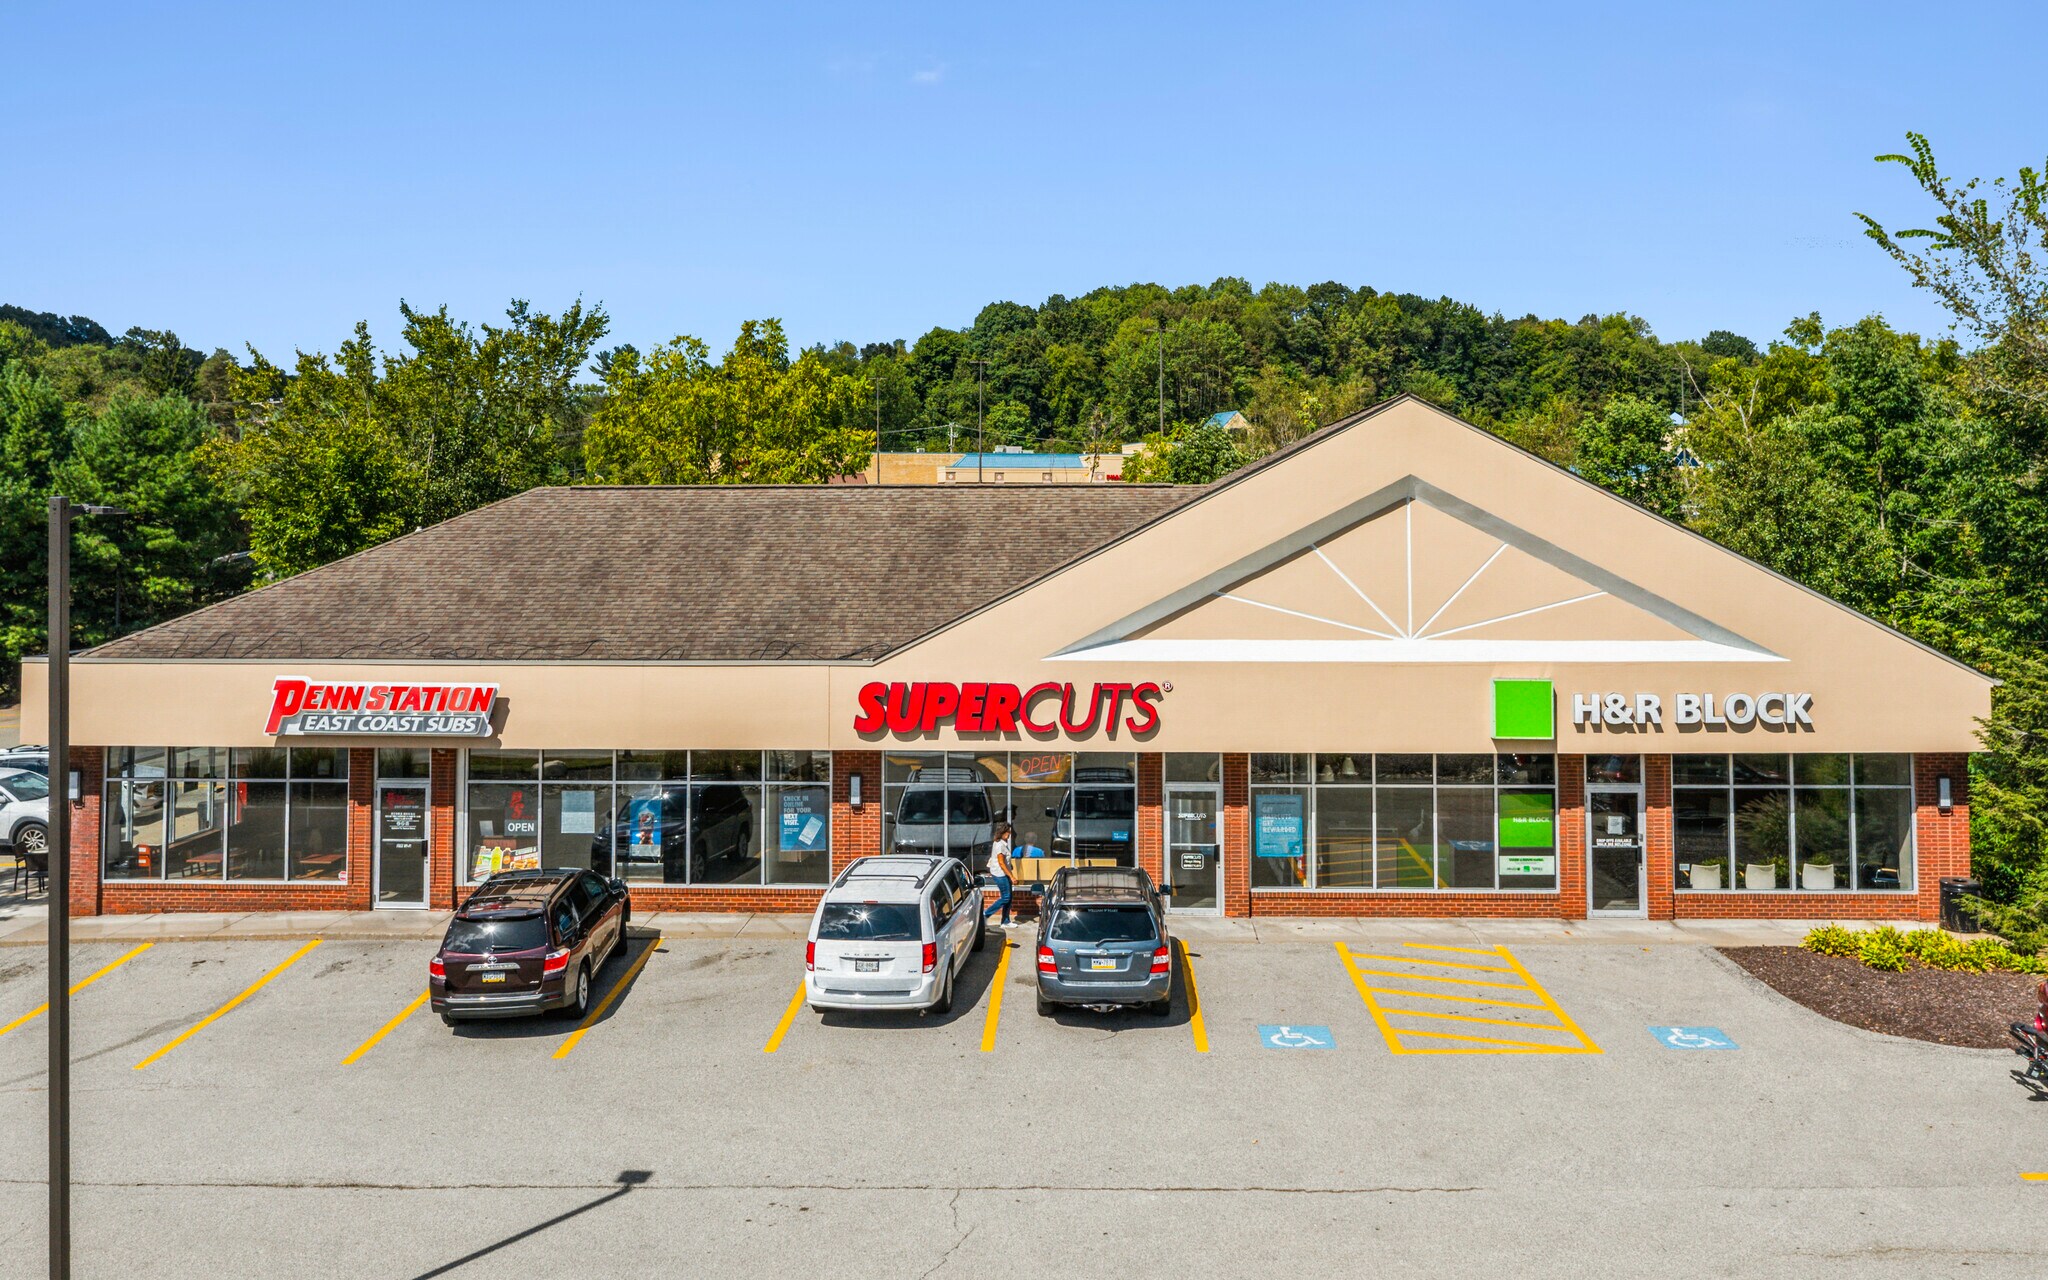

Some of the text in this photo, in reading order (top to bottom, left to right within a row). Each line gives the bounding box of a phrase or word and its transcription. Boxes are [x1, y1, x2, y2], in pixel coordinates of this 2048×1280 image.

[265, 680, 495, 733] PENN STATION
[1573, 692, 1814, 725] H&R BLOCK
[304, 715, 478, 733] EAST COAST SUBS
[1020, 754, 1061, 775] OPEN
[507, 822, 535, 832] OPEN
